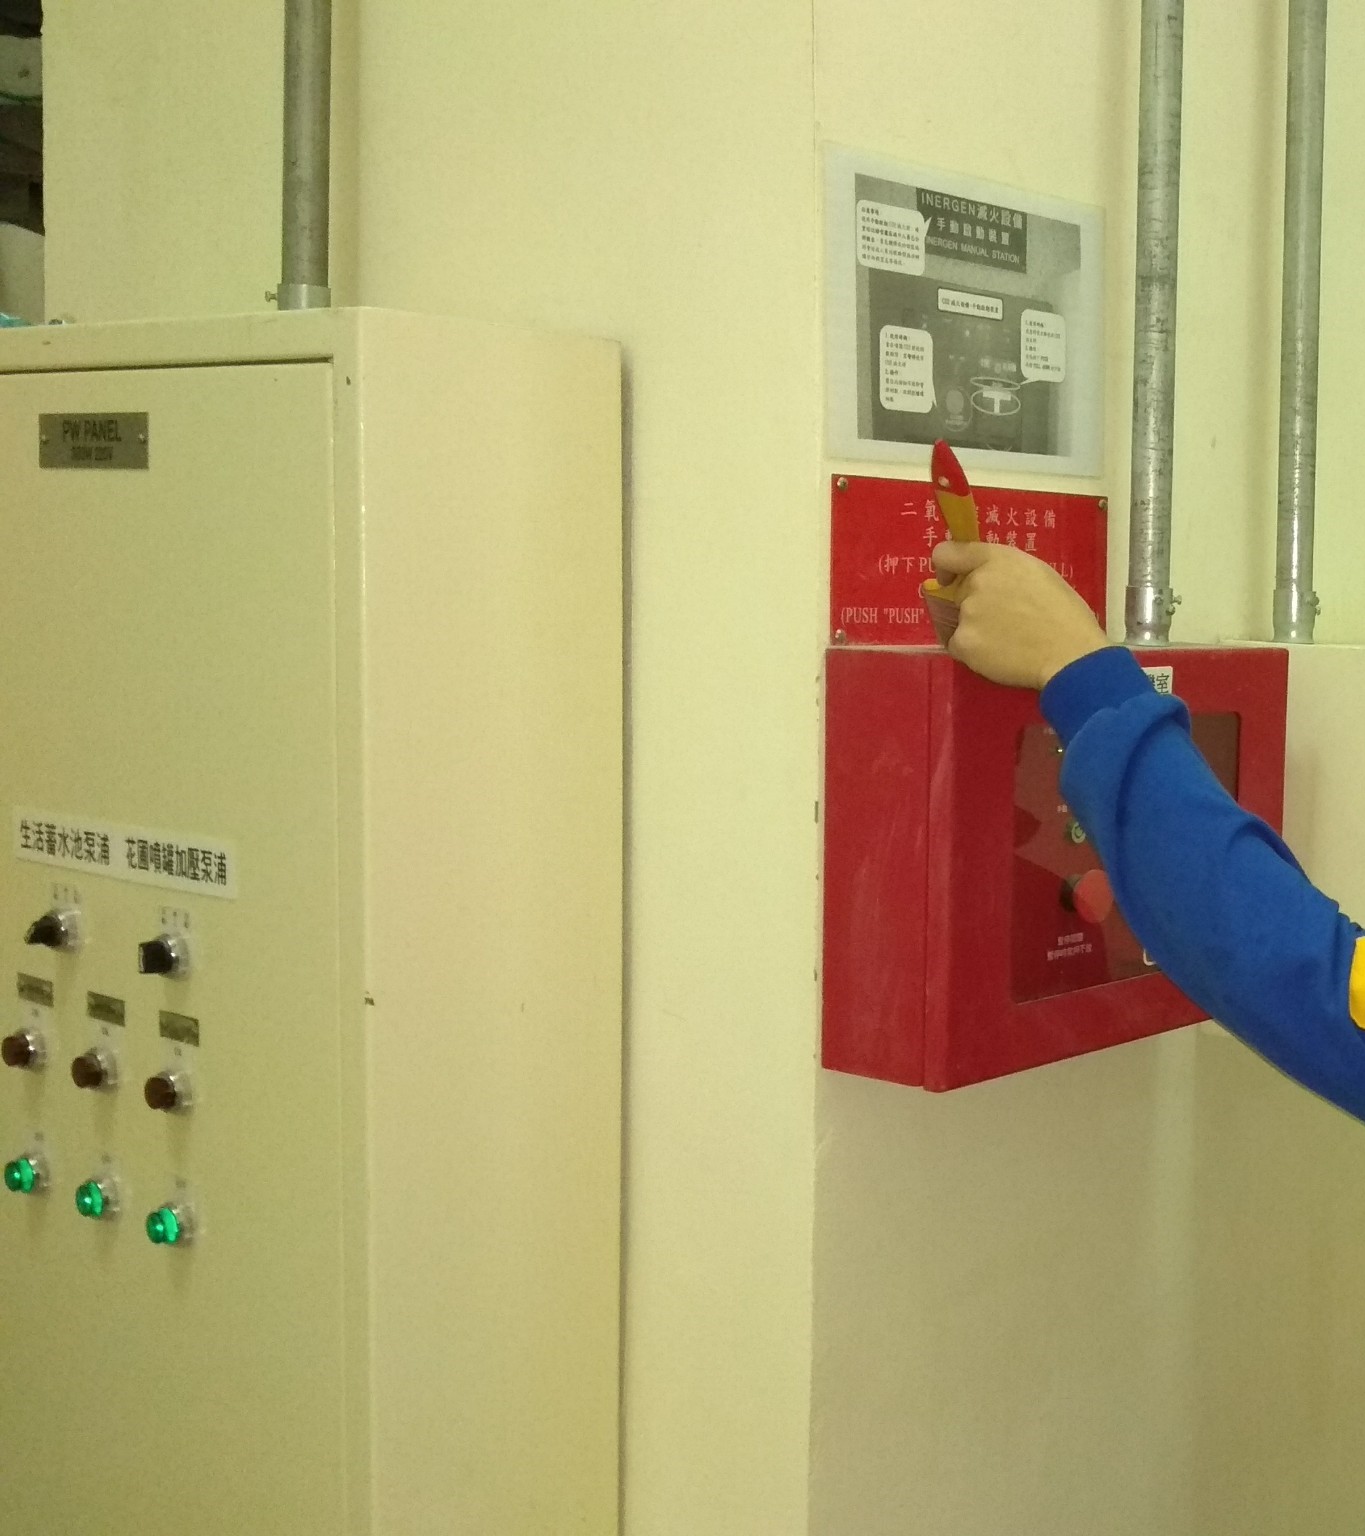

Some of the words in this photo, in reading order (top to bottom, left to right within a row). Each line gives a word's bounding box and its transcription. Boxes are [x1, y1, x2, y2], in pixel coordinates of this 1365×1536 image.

[960, 243, 989, 257] MANUAL
[991, 250, 1020, 263] STATION
[84, 419, 121, 441] PANEL
[901, 499, 1056, 529] 二氧滅火設備
